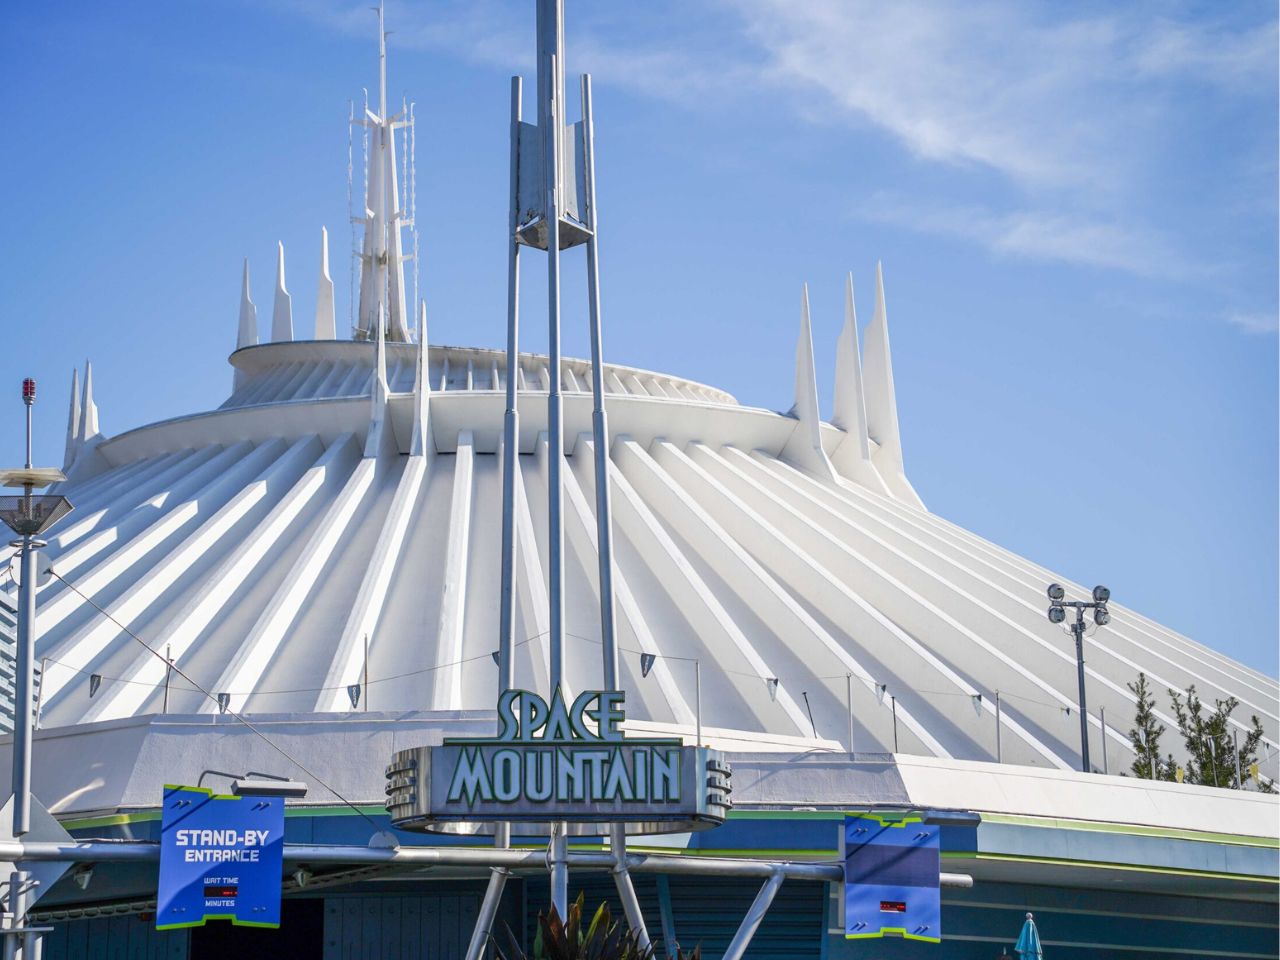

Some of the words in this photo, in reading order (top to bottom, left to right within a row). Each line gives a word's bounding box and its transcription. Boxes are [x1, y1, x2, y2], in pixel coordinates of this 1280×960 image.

[497, 682, 625, 742] SPACE
[447, 745, 681, 808] MOUNTAIN
[175, 829, 270, 846] STAND-BY
[185, 850, 260, 862] ENTRANCE
